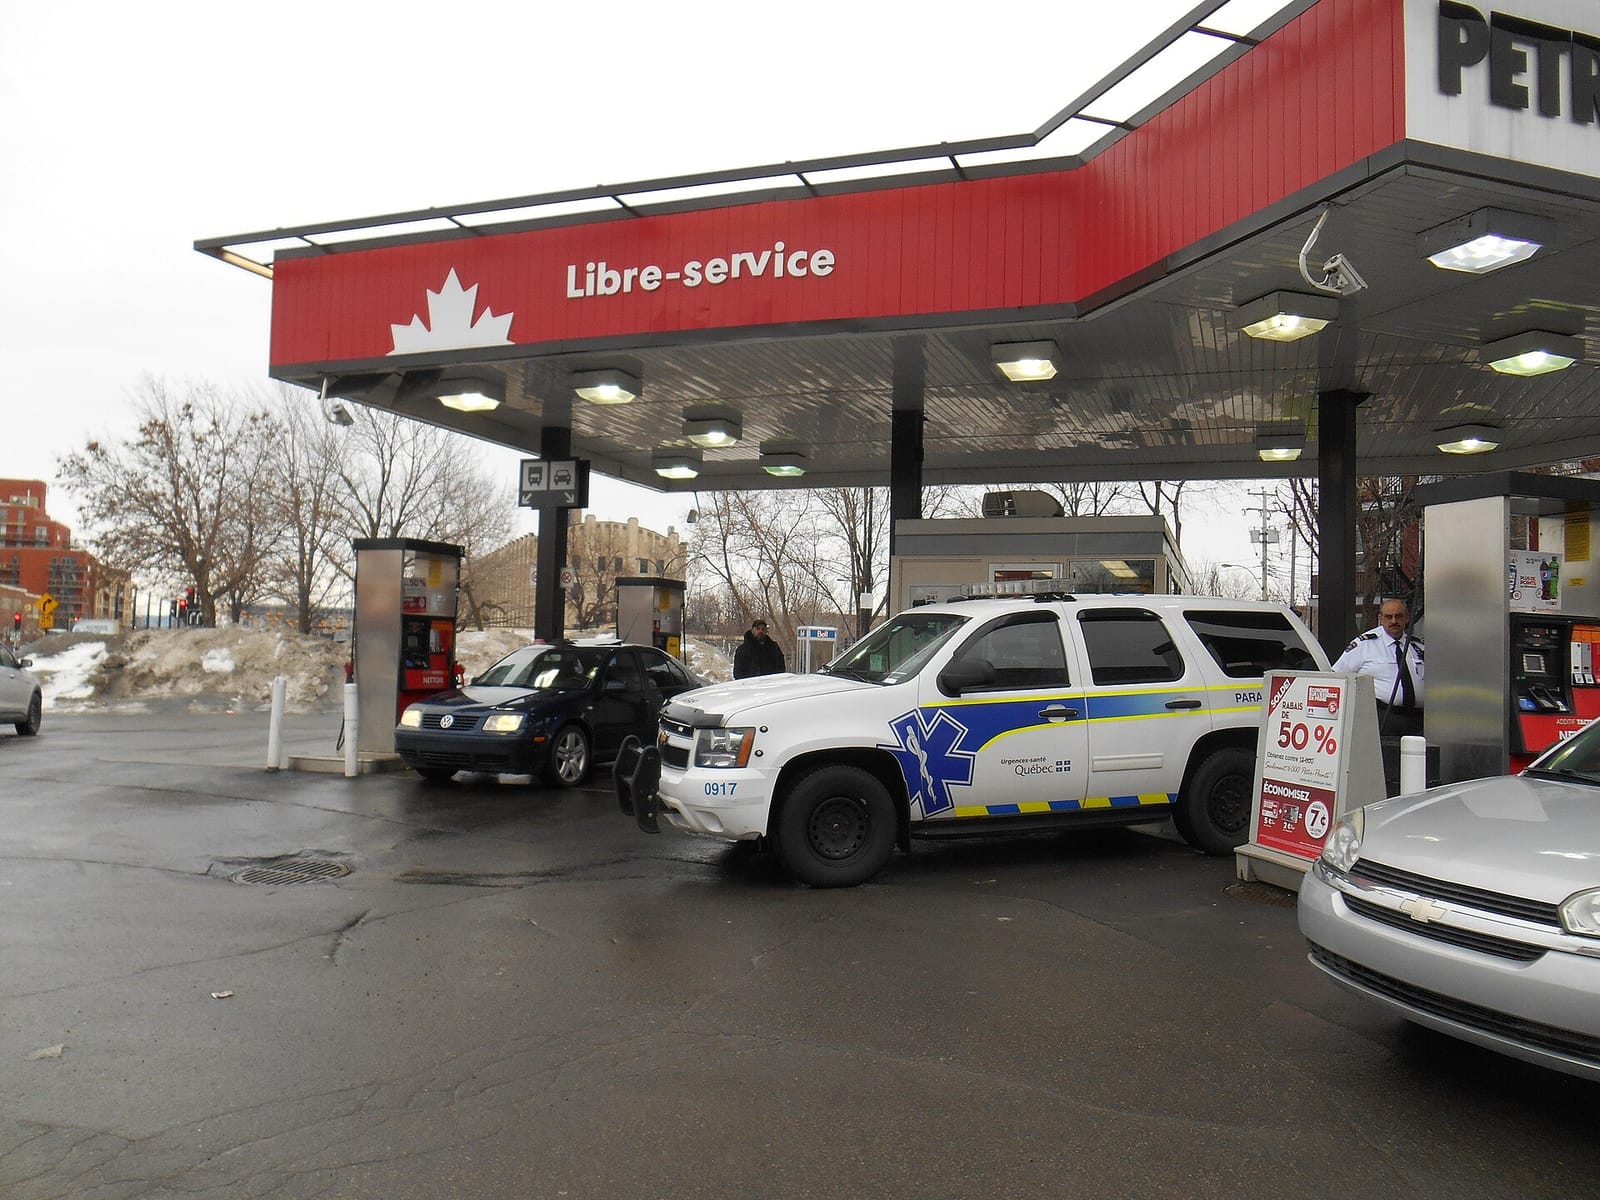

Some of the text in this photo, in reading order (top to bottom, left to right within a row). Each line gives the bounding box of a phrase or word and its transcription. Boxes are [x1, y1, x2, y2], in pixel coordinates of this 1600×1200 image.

[567, 241, 836, 299] Libre-service
[1235, 692, 1263, 703] PARA
[1282, 701, 1303, 711] RABAIS
[1281, 711, 1290, 720] DE
[1277, 721, 1337, 755] 50 %
[1000, 756, 1046, 765] Urgences-santé
[1014, 763, 1054, 776] Québec
[704, 782, 737, 796] 0917
[1263, 781, 1310, 801] ÉCONOMISEZ
